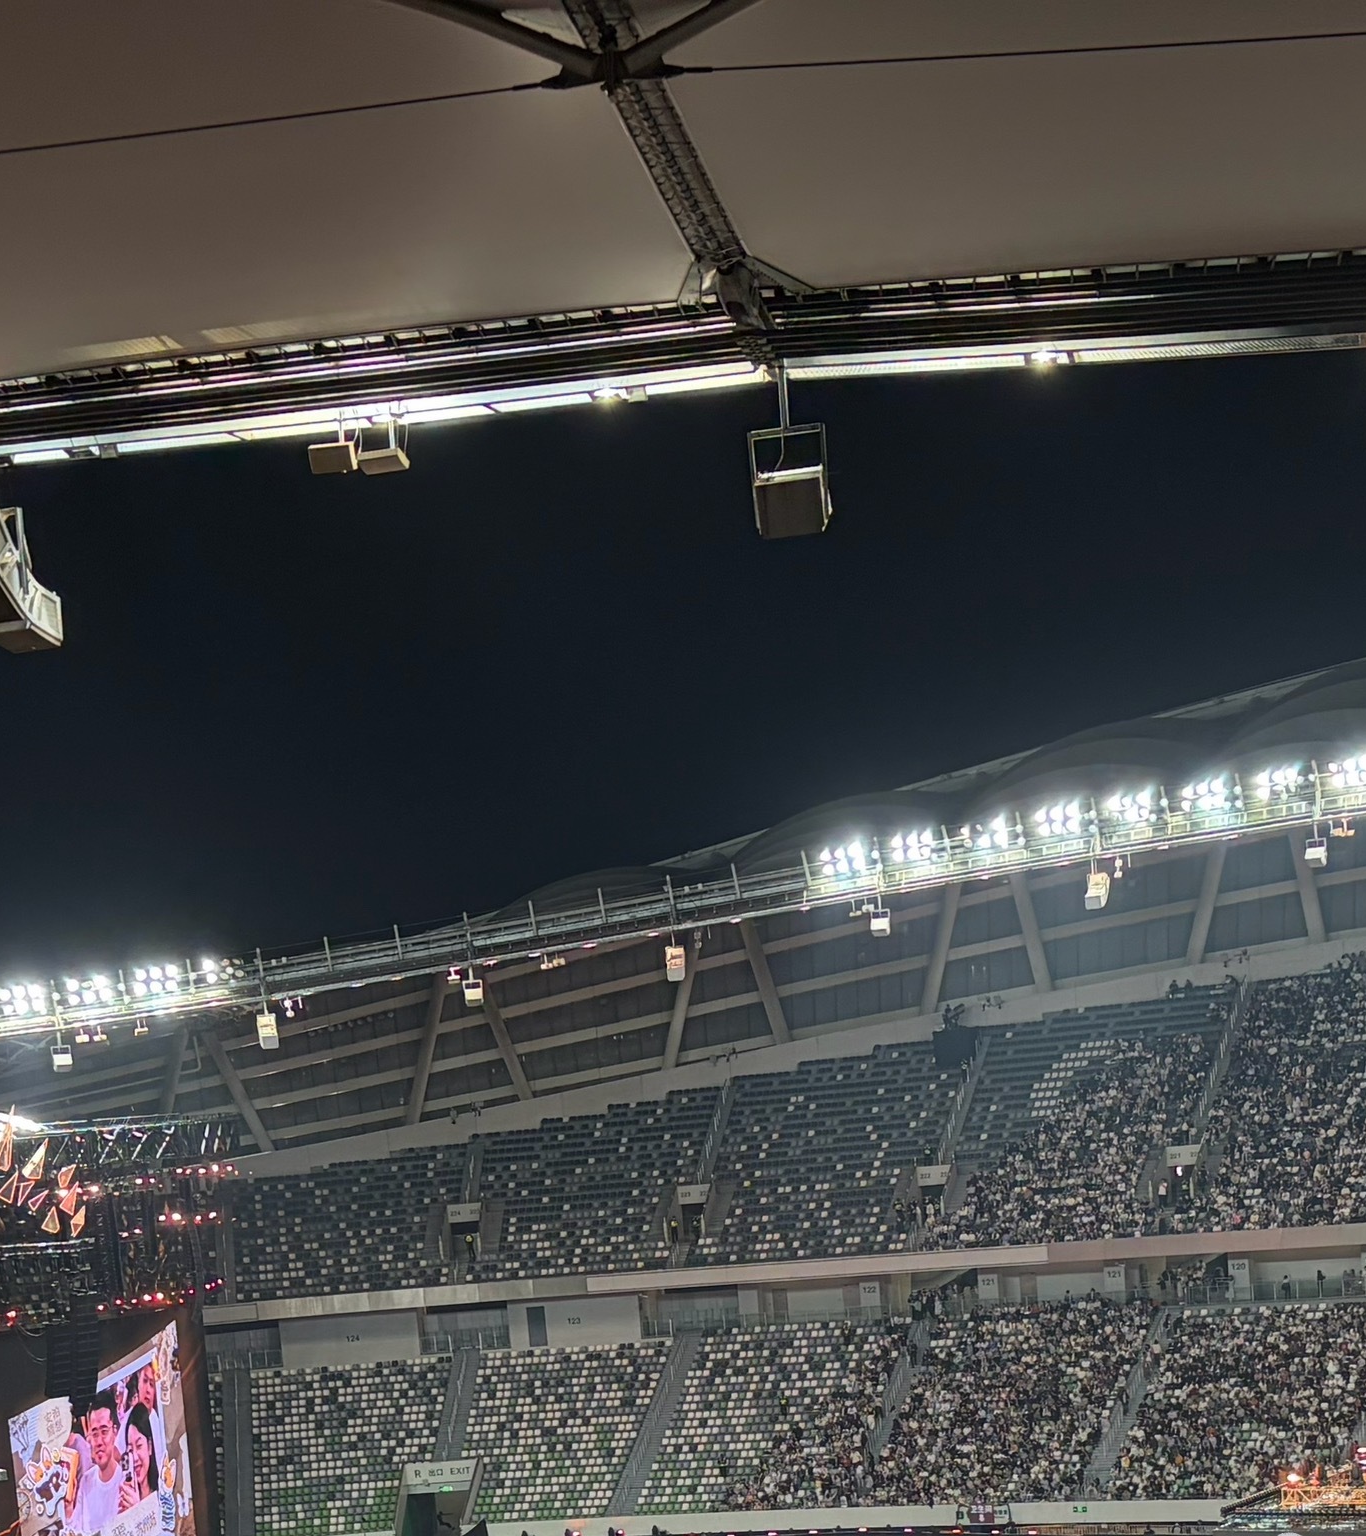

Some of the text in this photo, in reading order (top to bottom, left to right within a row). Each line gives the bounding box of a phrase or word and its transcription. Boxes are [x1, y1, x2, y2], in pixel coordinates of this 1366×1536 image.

[1231, 1262, 1246, 1271] 120
[1107, 1270, 1121, 1278] 121
[982, 1278, 995, 1286] 121
[567, 1317, 581, 1325] 123
[450, 1466, 470, 1475] EXIT
